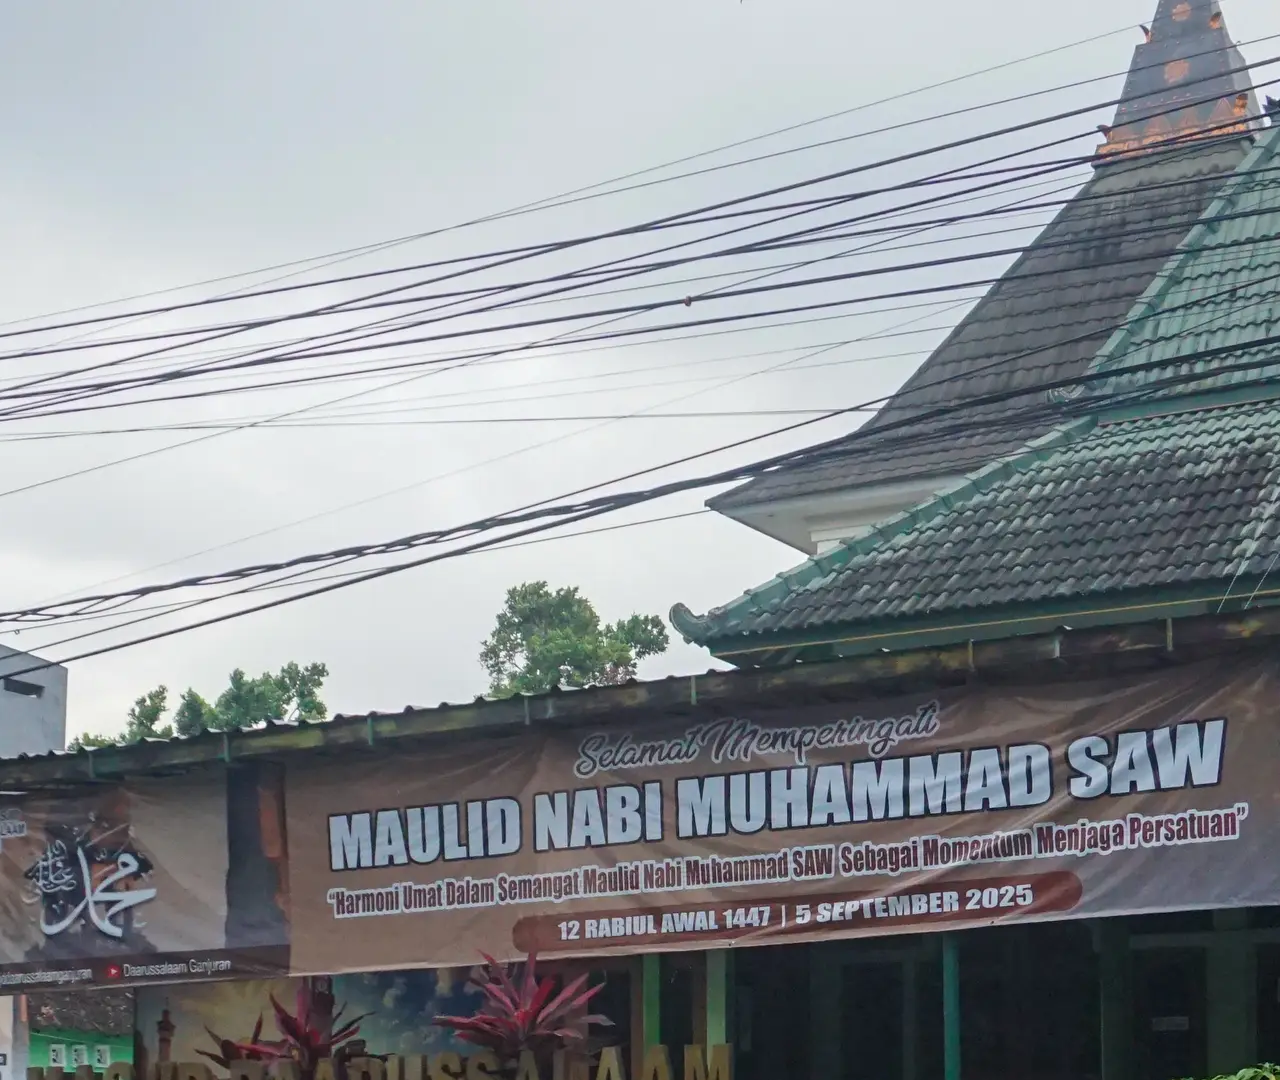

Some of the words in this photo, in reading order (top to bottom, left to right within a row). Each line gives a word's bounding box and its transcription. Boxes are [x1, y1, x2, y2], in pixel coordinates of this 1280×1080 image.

[575, 724, 701, 778] Selamat
[701, 701, 941, 766] Memperingati
[329, 797, 522, 871] MAULID
[533, 779, 664, 851] NABI
[676, 742, 1053, 840] MUHAMMAD
[1065, 717, 1227, 799] SAW
[403, 885, 443, 911] Umat
[446, 878, 494, 906] Dalam
[498, 871, 579, 902] Semangat
[583, 864, 639, 894] Maulid
[644, 860, 682, 889] Nabi
[686, 850, 789, 885] Muhammad
[793, 847, 833, 878] SAW
[841, 840, 919, 873] Sebagai
[923, 830, 1032, 867] Momentum
[1036, 819, 1124, 856] Menjaga
[557, 919, 580, 941] 12
[585, 914, 657, 939] RABIUL
[661, 911, 718, 935] AWAL
[722, 906, 770, 930] 1447
[795, 905, 811, 925] 5
[816, 891, 959, 922] SEPTEMBER
[965, 883, 1033, 911] 2025
[123, 960, 187, 978] Daarussalaam
[189, 958, 231, 976] Ganjuran
